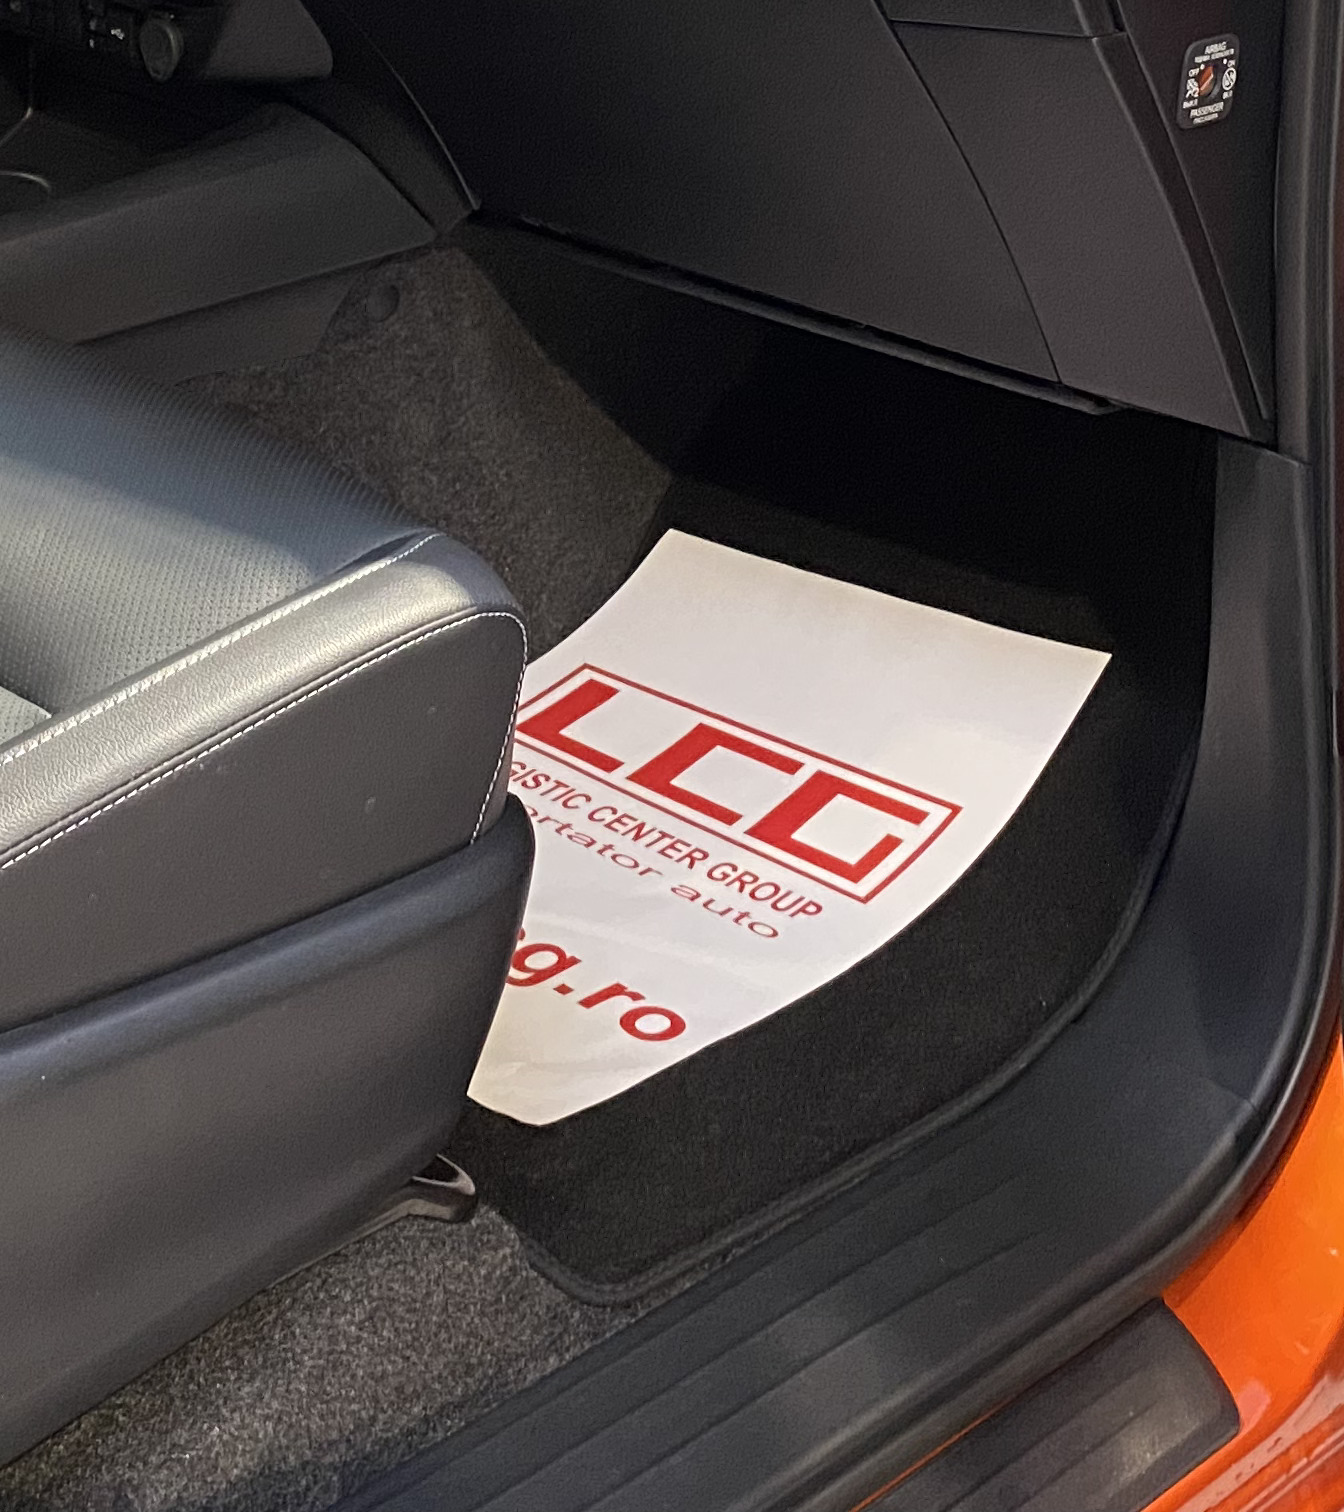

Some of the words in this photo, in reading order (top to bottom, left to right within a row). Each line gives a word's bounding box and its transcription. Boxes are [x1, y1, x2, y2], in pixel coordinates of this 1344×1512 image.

[516, 678, 930, 884] LCG
[587, 805, 710, 870] CENTER
[706, 861, 823, 918] GROUP
[670, 884, 779, 939] auto
[506, 927, 686, 1042] g.ro
